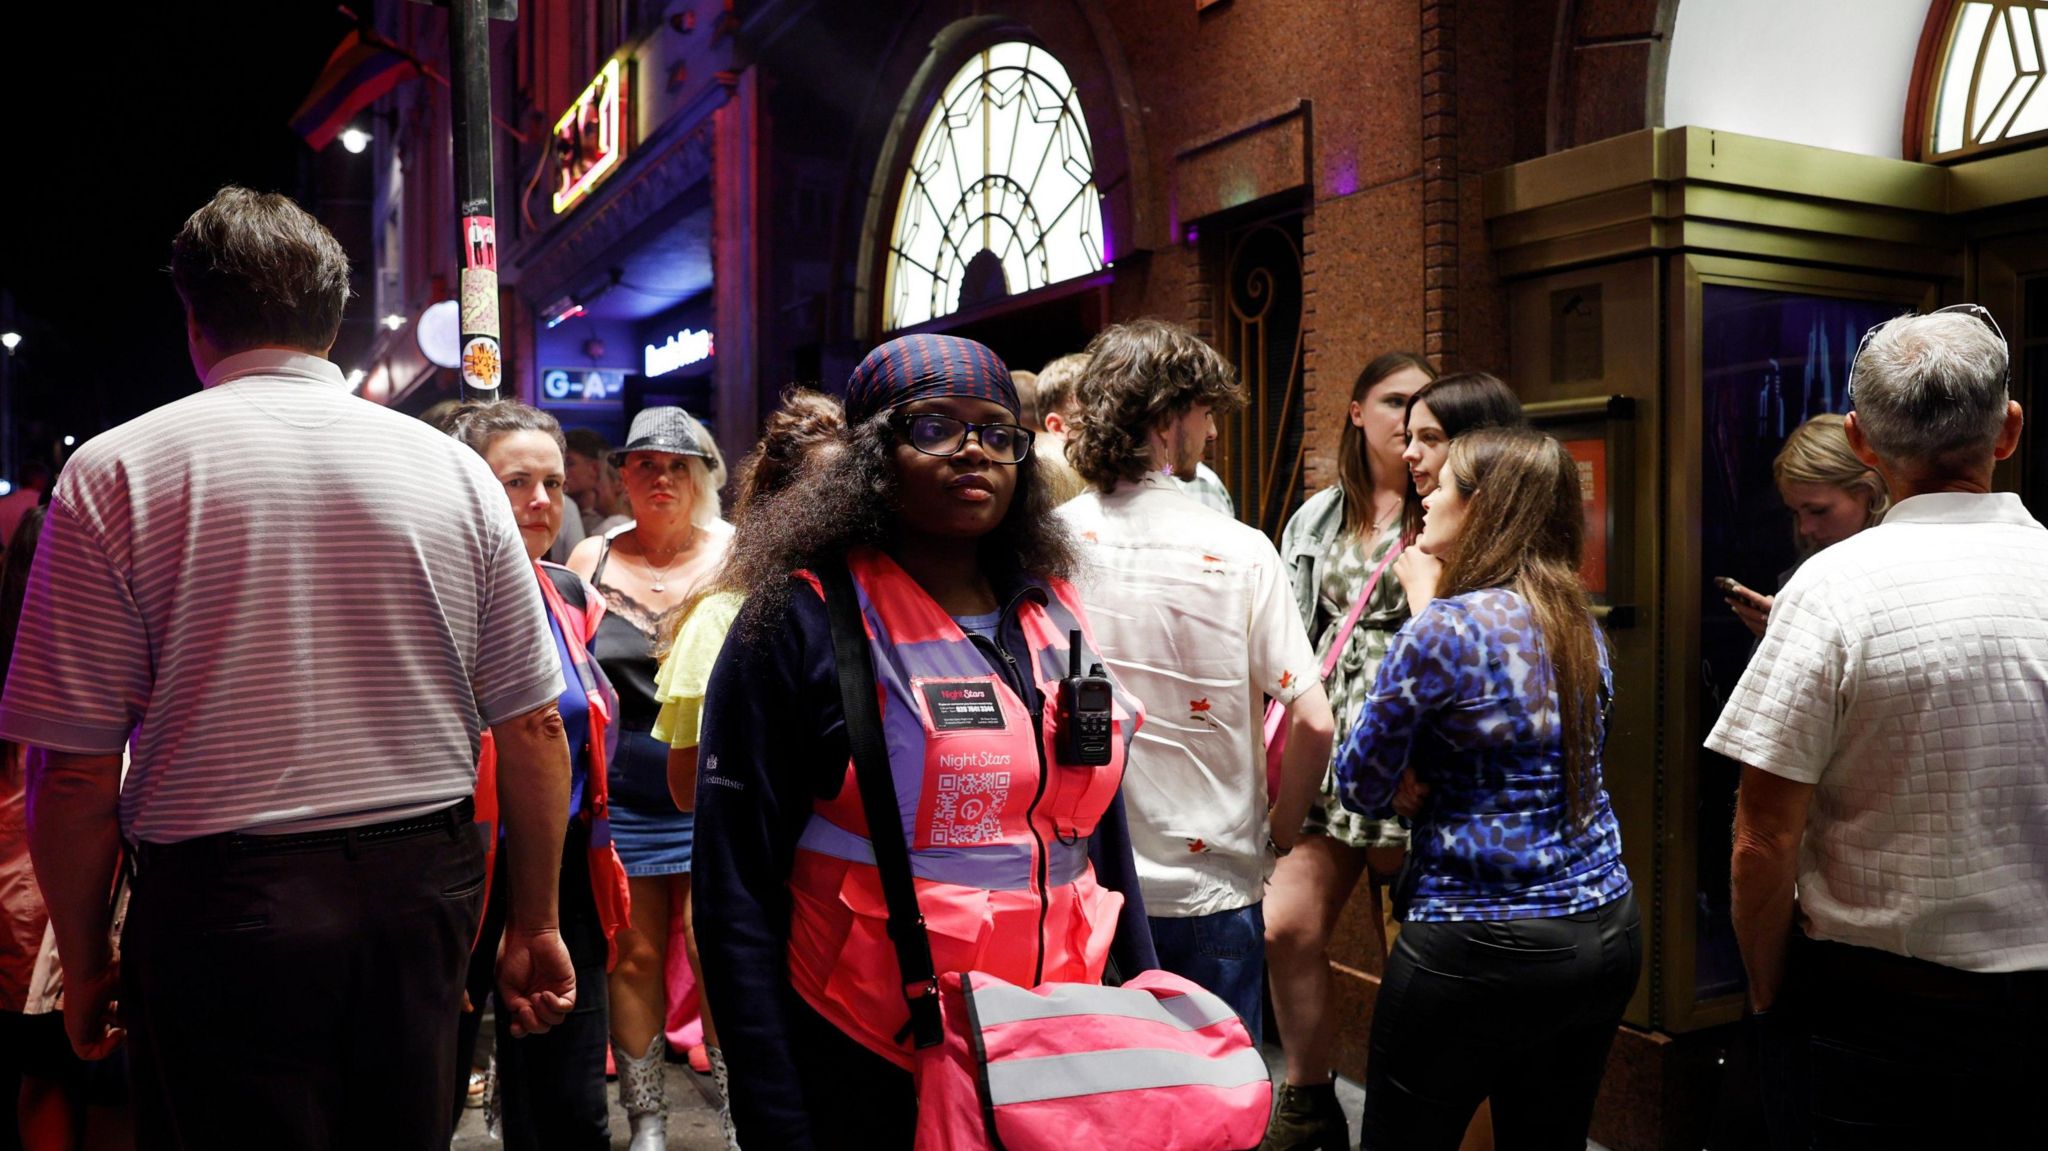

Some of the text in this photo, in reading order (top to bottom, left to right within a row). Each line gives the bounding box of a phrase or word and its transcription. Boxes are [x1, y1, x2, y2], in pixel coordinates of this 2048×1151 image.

[941, 689, 985, 701] Night Stars
[940, 751, 1010, 771] Night Stars
